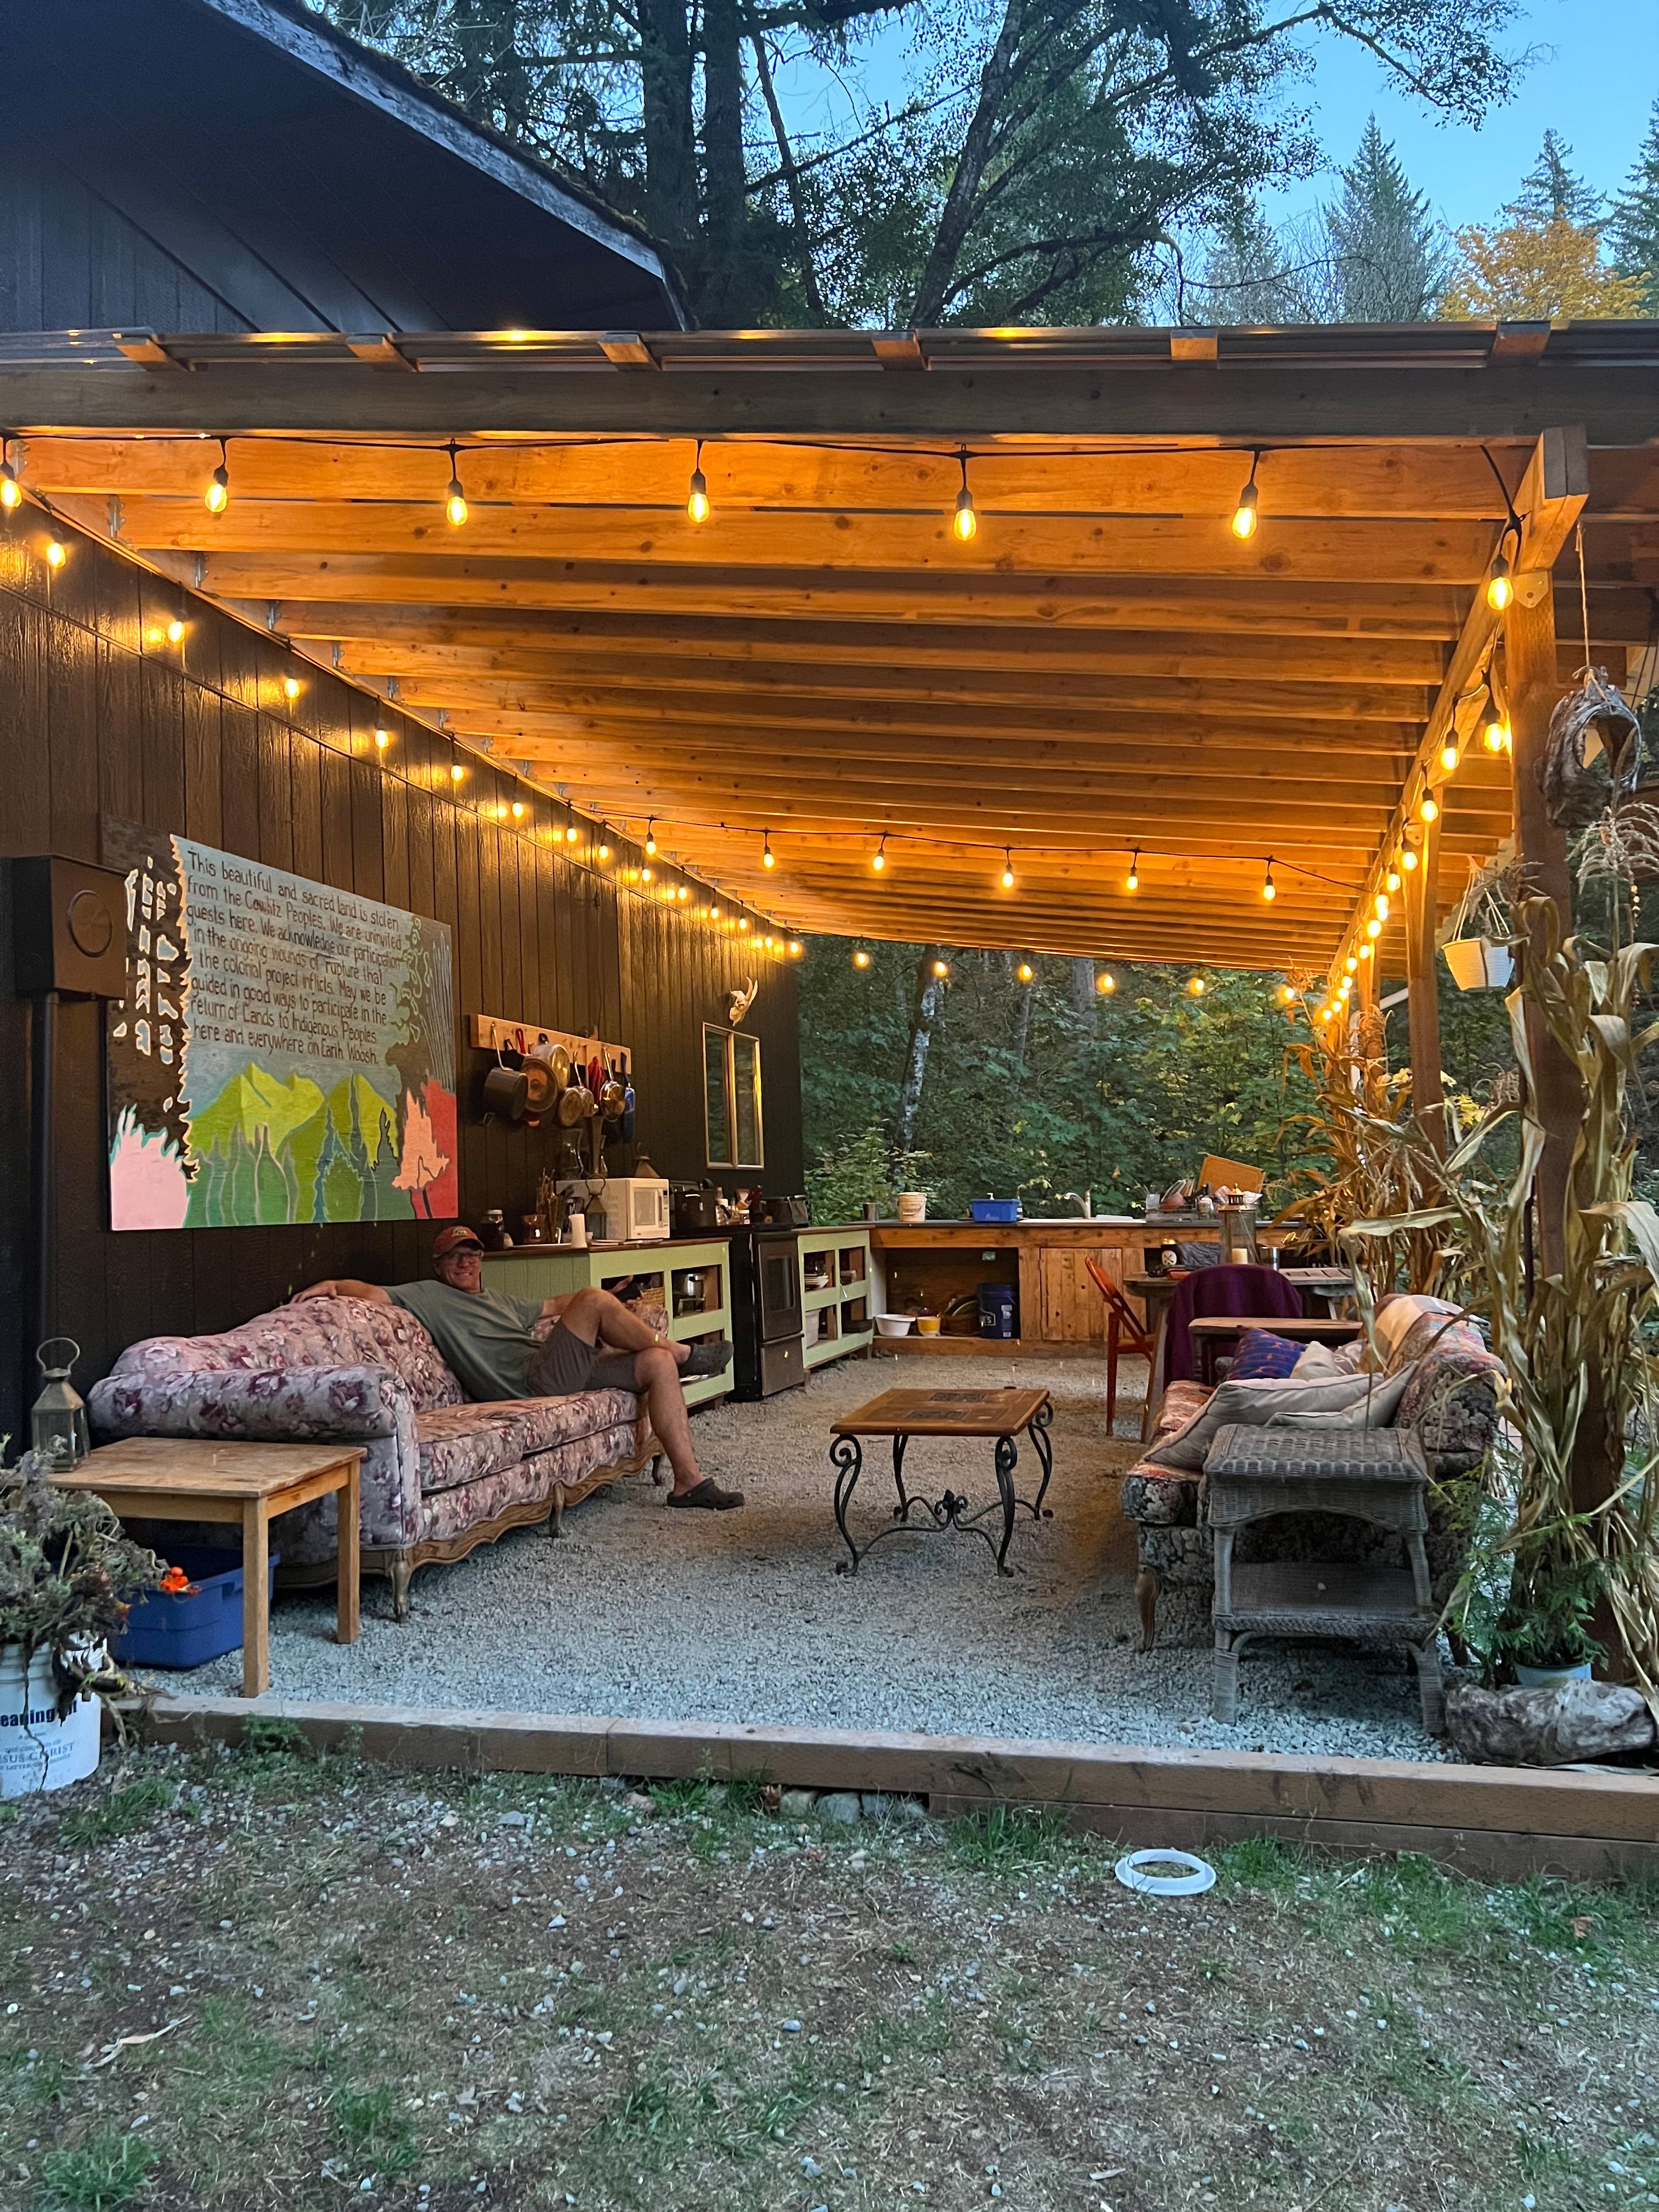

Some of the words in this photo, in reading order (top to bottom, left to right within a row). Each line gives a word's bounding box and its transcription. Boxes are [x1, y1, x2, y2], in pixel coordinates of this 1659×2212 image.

[188, 850, 216, 877] This
[222, 861, 272, 893] beautiful
[278, 882, 297, 901] and
[302, 891, 335, 912] sacred
[337, 895, 357, 919] land
[360, 905, 368, 922] is
[371, 911, 399, 932] stolen
[188, 875, 218, 900] from
[224, 885, 241, 906] the
[286, 901, 326, 932] Peoples.
[330, 915, 343, 936] We
[346, 925, 362, 940] are
[365, 929, 401, 951] uninvited
[187, 905, 225, 926] guests
[229, 909, 258, 933] here.
[260, 917, 275, 938] We
[278, 924, 335, 953] acknowledge
[337, 943, 351, 957] our
[194, 923, 205, 944] in
[206, 926, 226, 948] the
[230, 937, 267, 964] ongoing
[272, 946, 306, 968] wounds
[310, 952, 320, 971] of
[325, 960, 359, 980] rupture
[363, 965, 382, 985] that
[191, 974, 227, 998] guided
[230, 978, 240, 998] in
[244, 987, 270, 1006] good
[273, 992, 296, 1013] ways
[300, 994, 309, 1011] to
[312, 998, 358, 1022] participate
[361, 1005, 370, 1022] in
[372, 1006, 387, 1026] the
[200, 947, 219, 969] the
[224, 954, 262, 979] colonial
[266, 968, 298, 990] project
[338, 979, 356, 1005] May
[360, 989, 371, 1002] we
[375, 987, 386, 1006] be
[191, 997, 226, 1019] return
[228, 1000, 239, 1020] of
[243, 1002, 275, 1027] Lands
[279, 1011, 289, 1029] to
[292, 1011, 338, 1039] Indigenous
[342, 1020, 377, 1047] Peoples
[194, 1018, 219, 1041] here
[224, 1027, 244, 1045] and
[248, 1030, 303, 1056] everywhere
[308, 1040, 319, 1056] on
